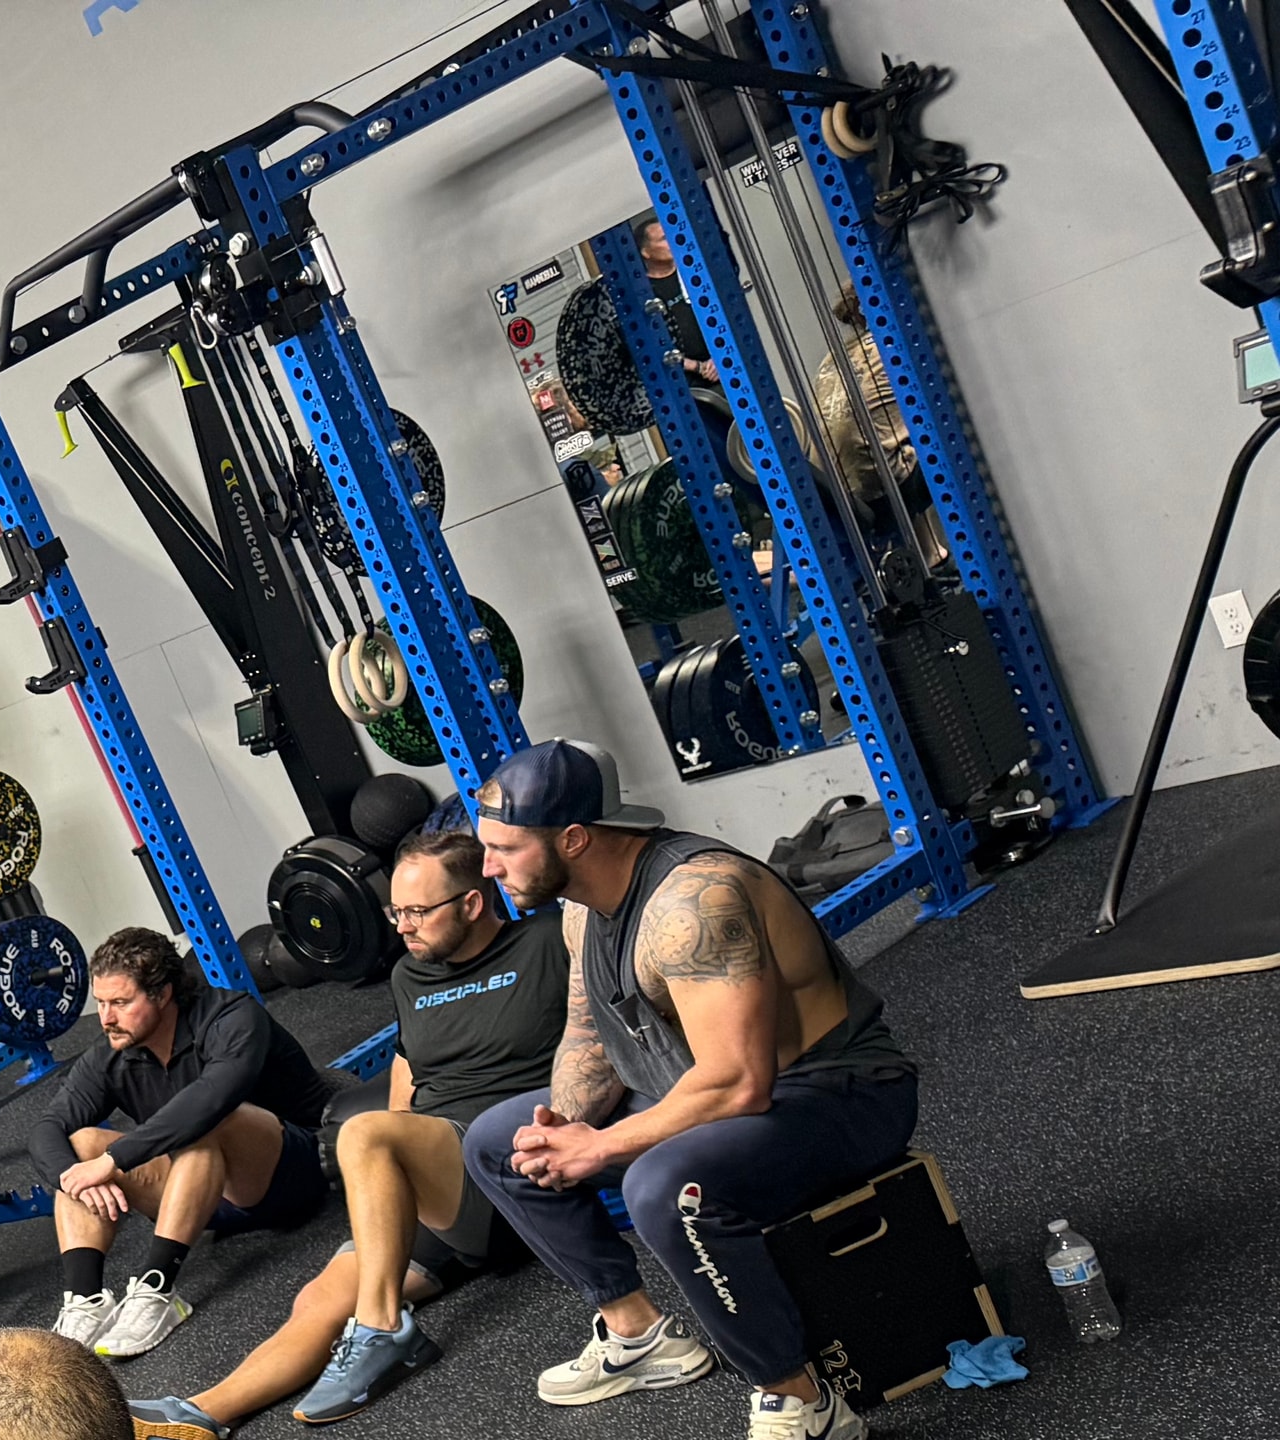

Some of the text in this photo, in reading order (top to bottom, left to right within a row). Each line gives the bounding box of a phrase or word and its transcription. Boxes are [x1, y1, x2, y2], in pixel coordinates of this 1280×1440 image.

[743, 174, 754, 187] IT
[232, 492, 276, 601] concept 2
[606, 571, 637, 588] SERVE.
[0, 943, 27, 1020] ROGUE
[414, 970, 519, 1010] DISCIPLED
[678, 1182, 738, 1314] Champion
[819, 1339, 849, 1374] 12
